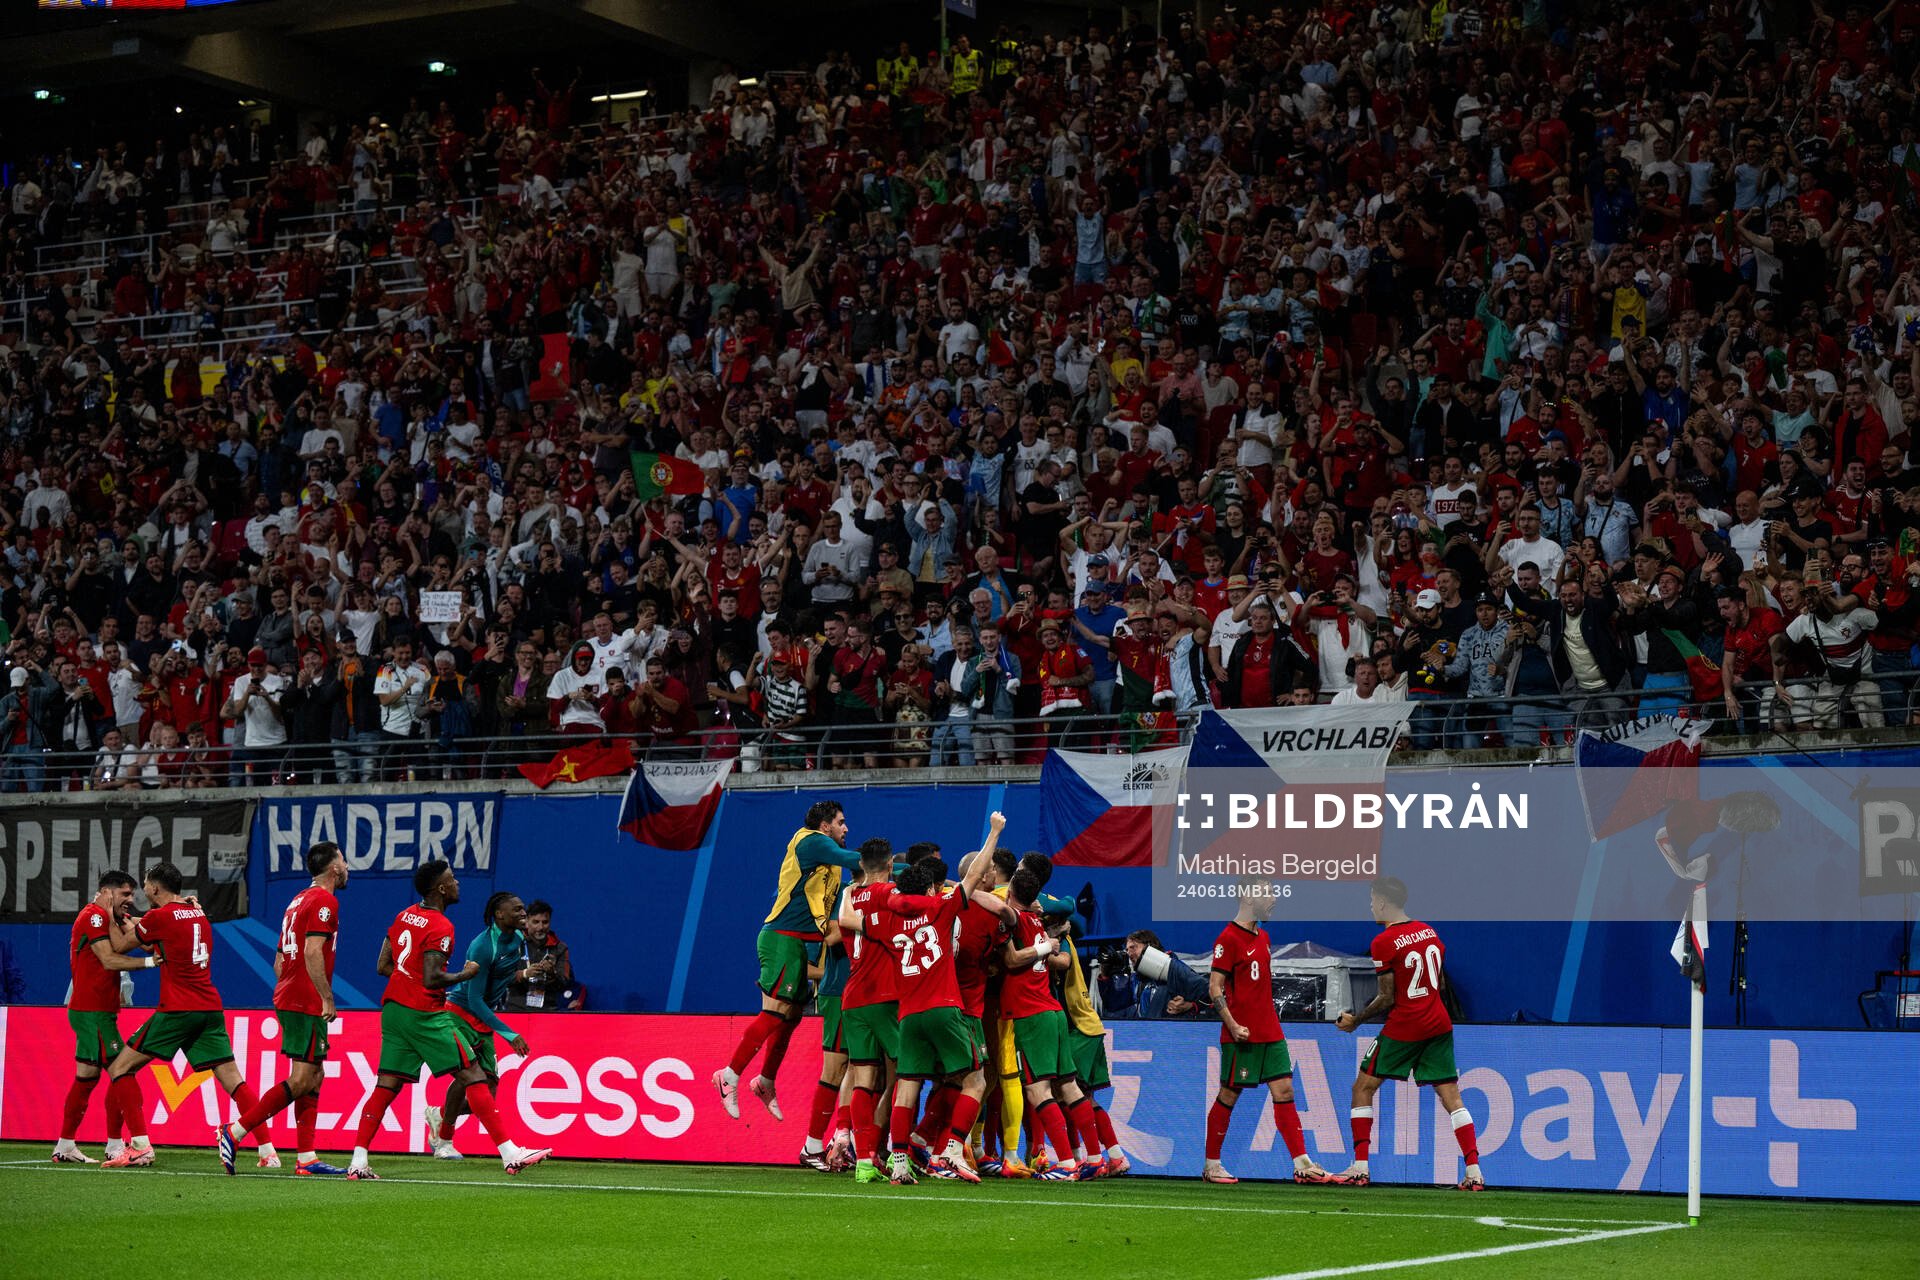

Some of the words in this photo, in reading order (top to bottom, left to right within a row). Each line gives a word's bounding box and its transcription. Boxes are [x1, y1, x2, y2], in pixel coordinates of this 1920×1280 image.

[600, 657, 605, 668] 5
[180, 686, 186, 696] 7
[1263, 720, 1401, 752] VRCHLABÍ
[268, 801, 495, 873] HADERN
[192, 923, 210, 970] 4
[281, 911, 298, 960] 14
[397, 929, 414, 979] 2
[892, 925, 944, 977] 23
[1394, 934, 1413, 951] JOÃO
[1250, 960, 1260, 981] 8
[1405, 944, 1443, 1000] 20
